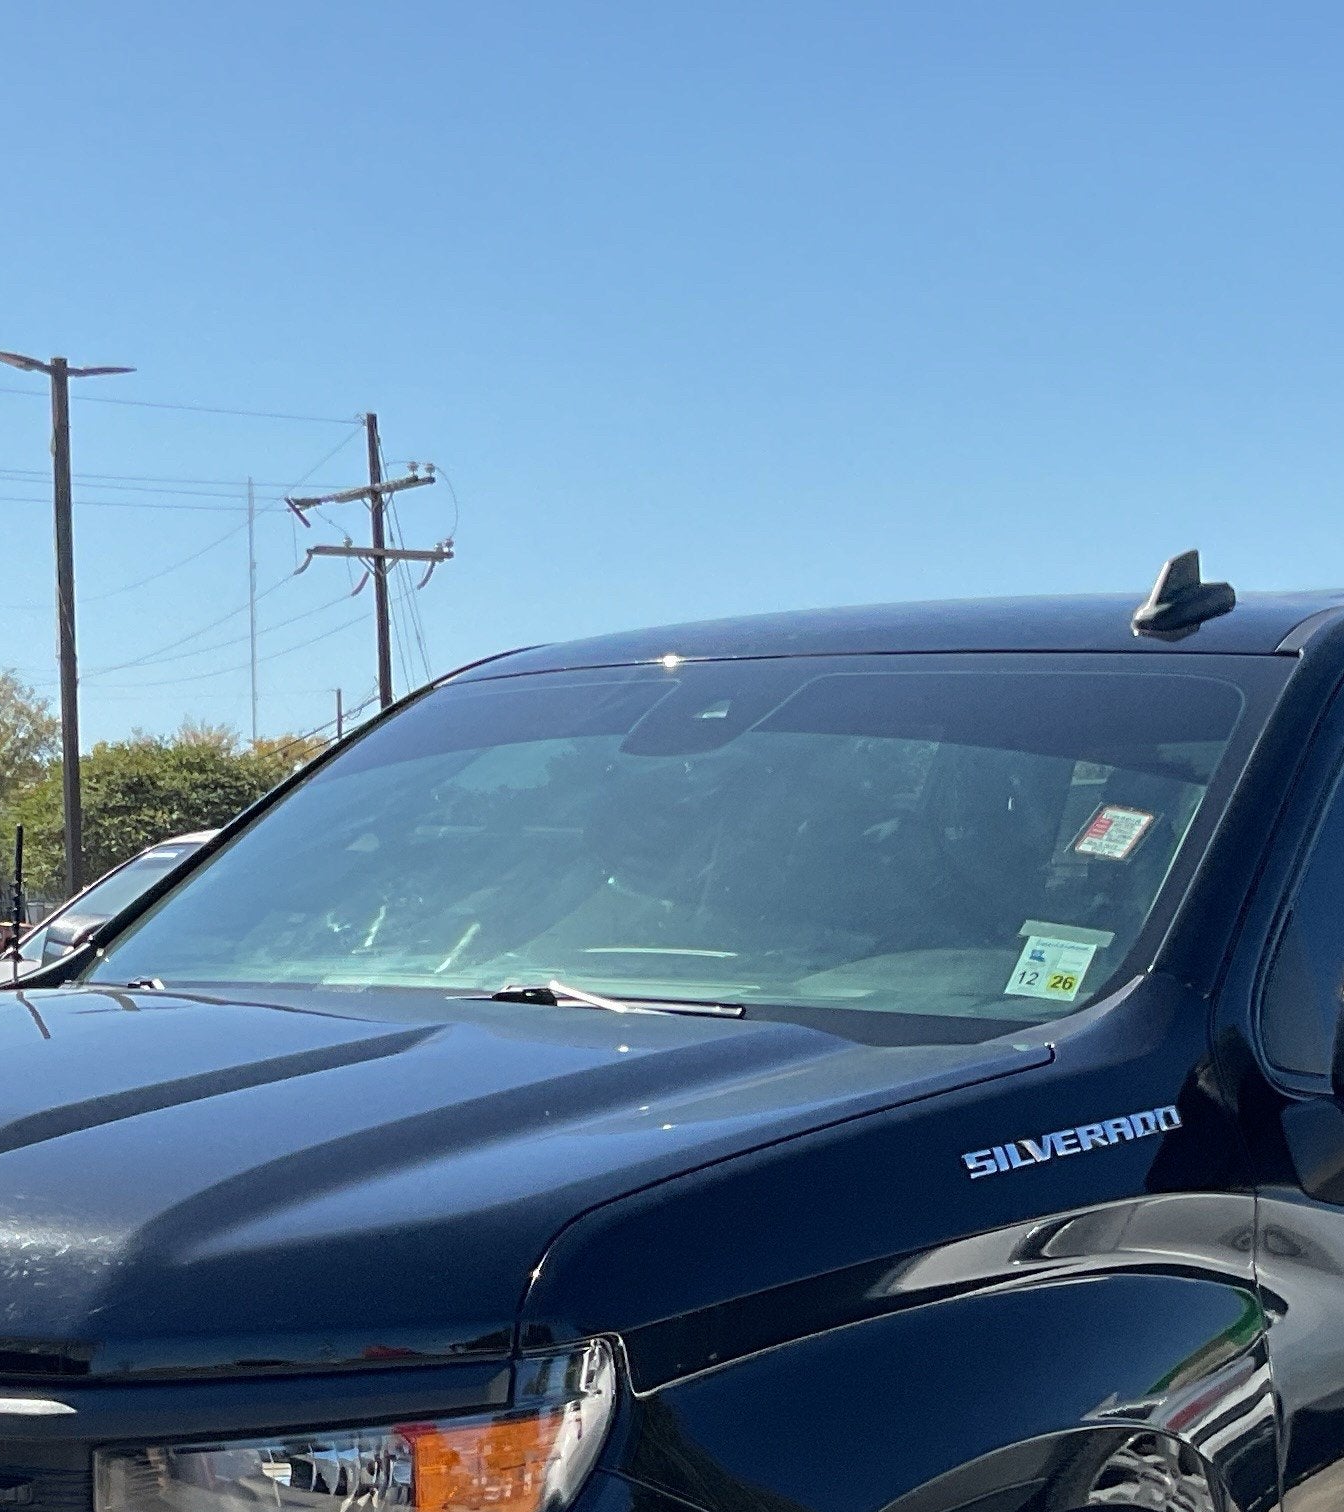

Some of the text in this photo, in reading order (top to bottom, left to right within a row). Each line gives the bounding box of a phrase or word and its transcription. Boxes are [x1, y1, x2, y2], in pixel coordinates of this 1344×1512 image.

[1018, 971, 1076, 991] 12 26
[962, 1104, 1182, 1179] SILVERADO
